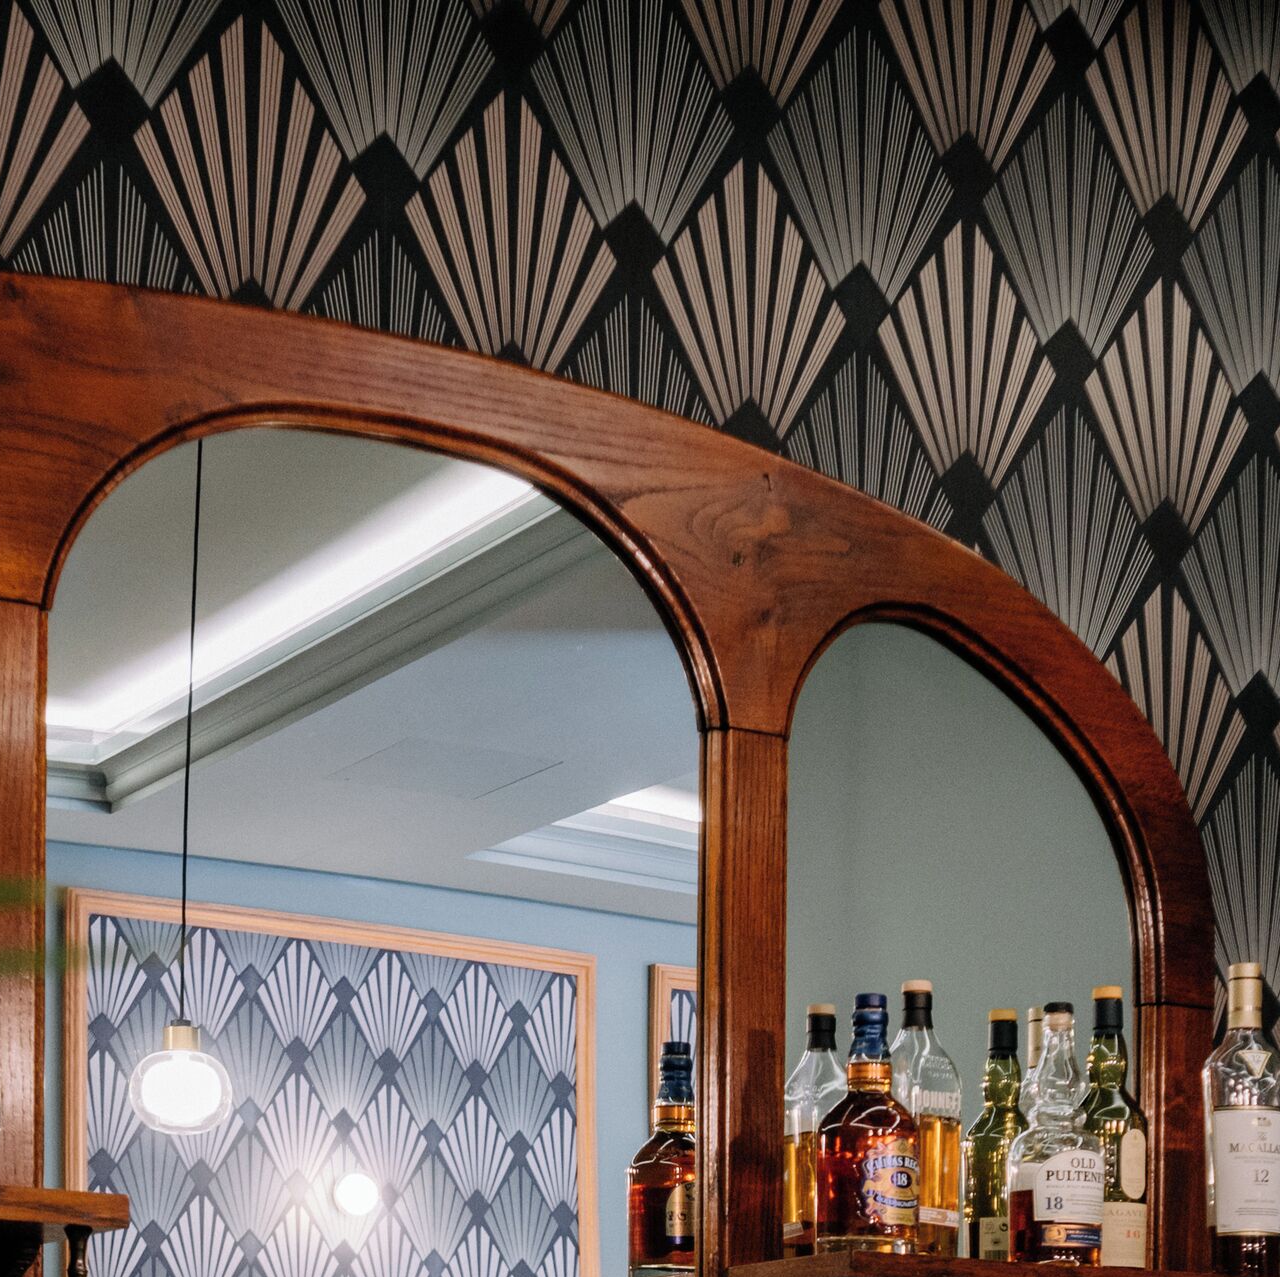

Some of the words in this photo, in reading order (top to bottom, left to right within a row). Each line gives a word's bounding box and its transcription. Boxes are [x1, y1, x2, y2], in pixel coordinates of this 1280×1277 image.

[1071, 1158, 1096, 1169] OLD
[897, 1173, 908, 1186] 18
[1046, 1170, 1105, 1184] PULTENE
[1254, 1169, 1269, 1182] 12
[1045, 1197, 1063, 1210] 18
